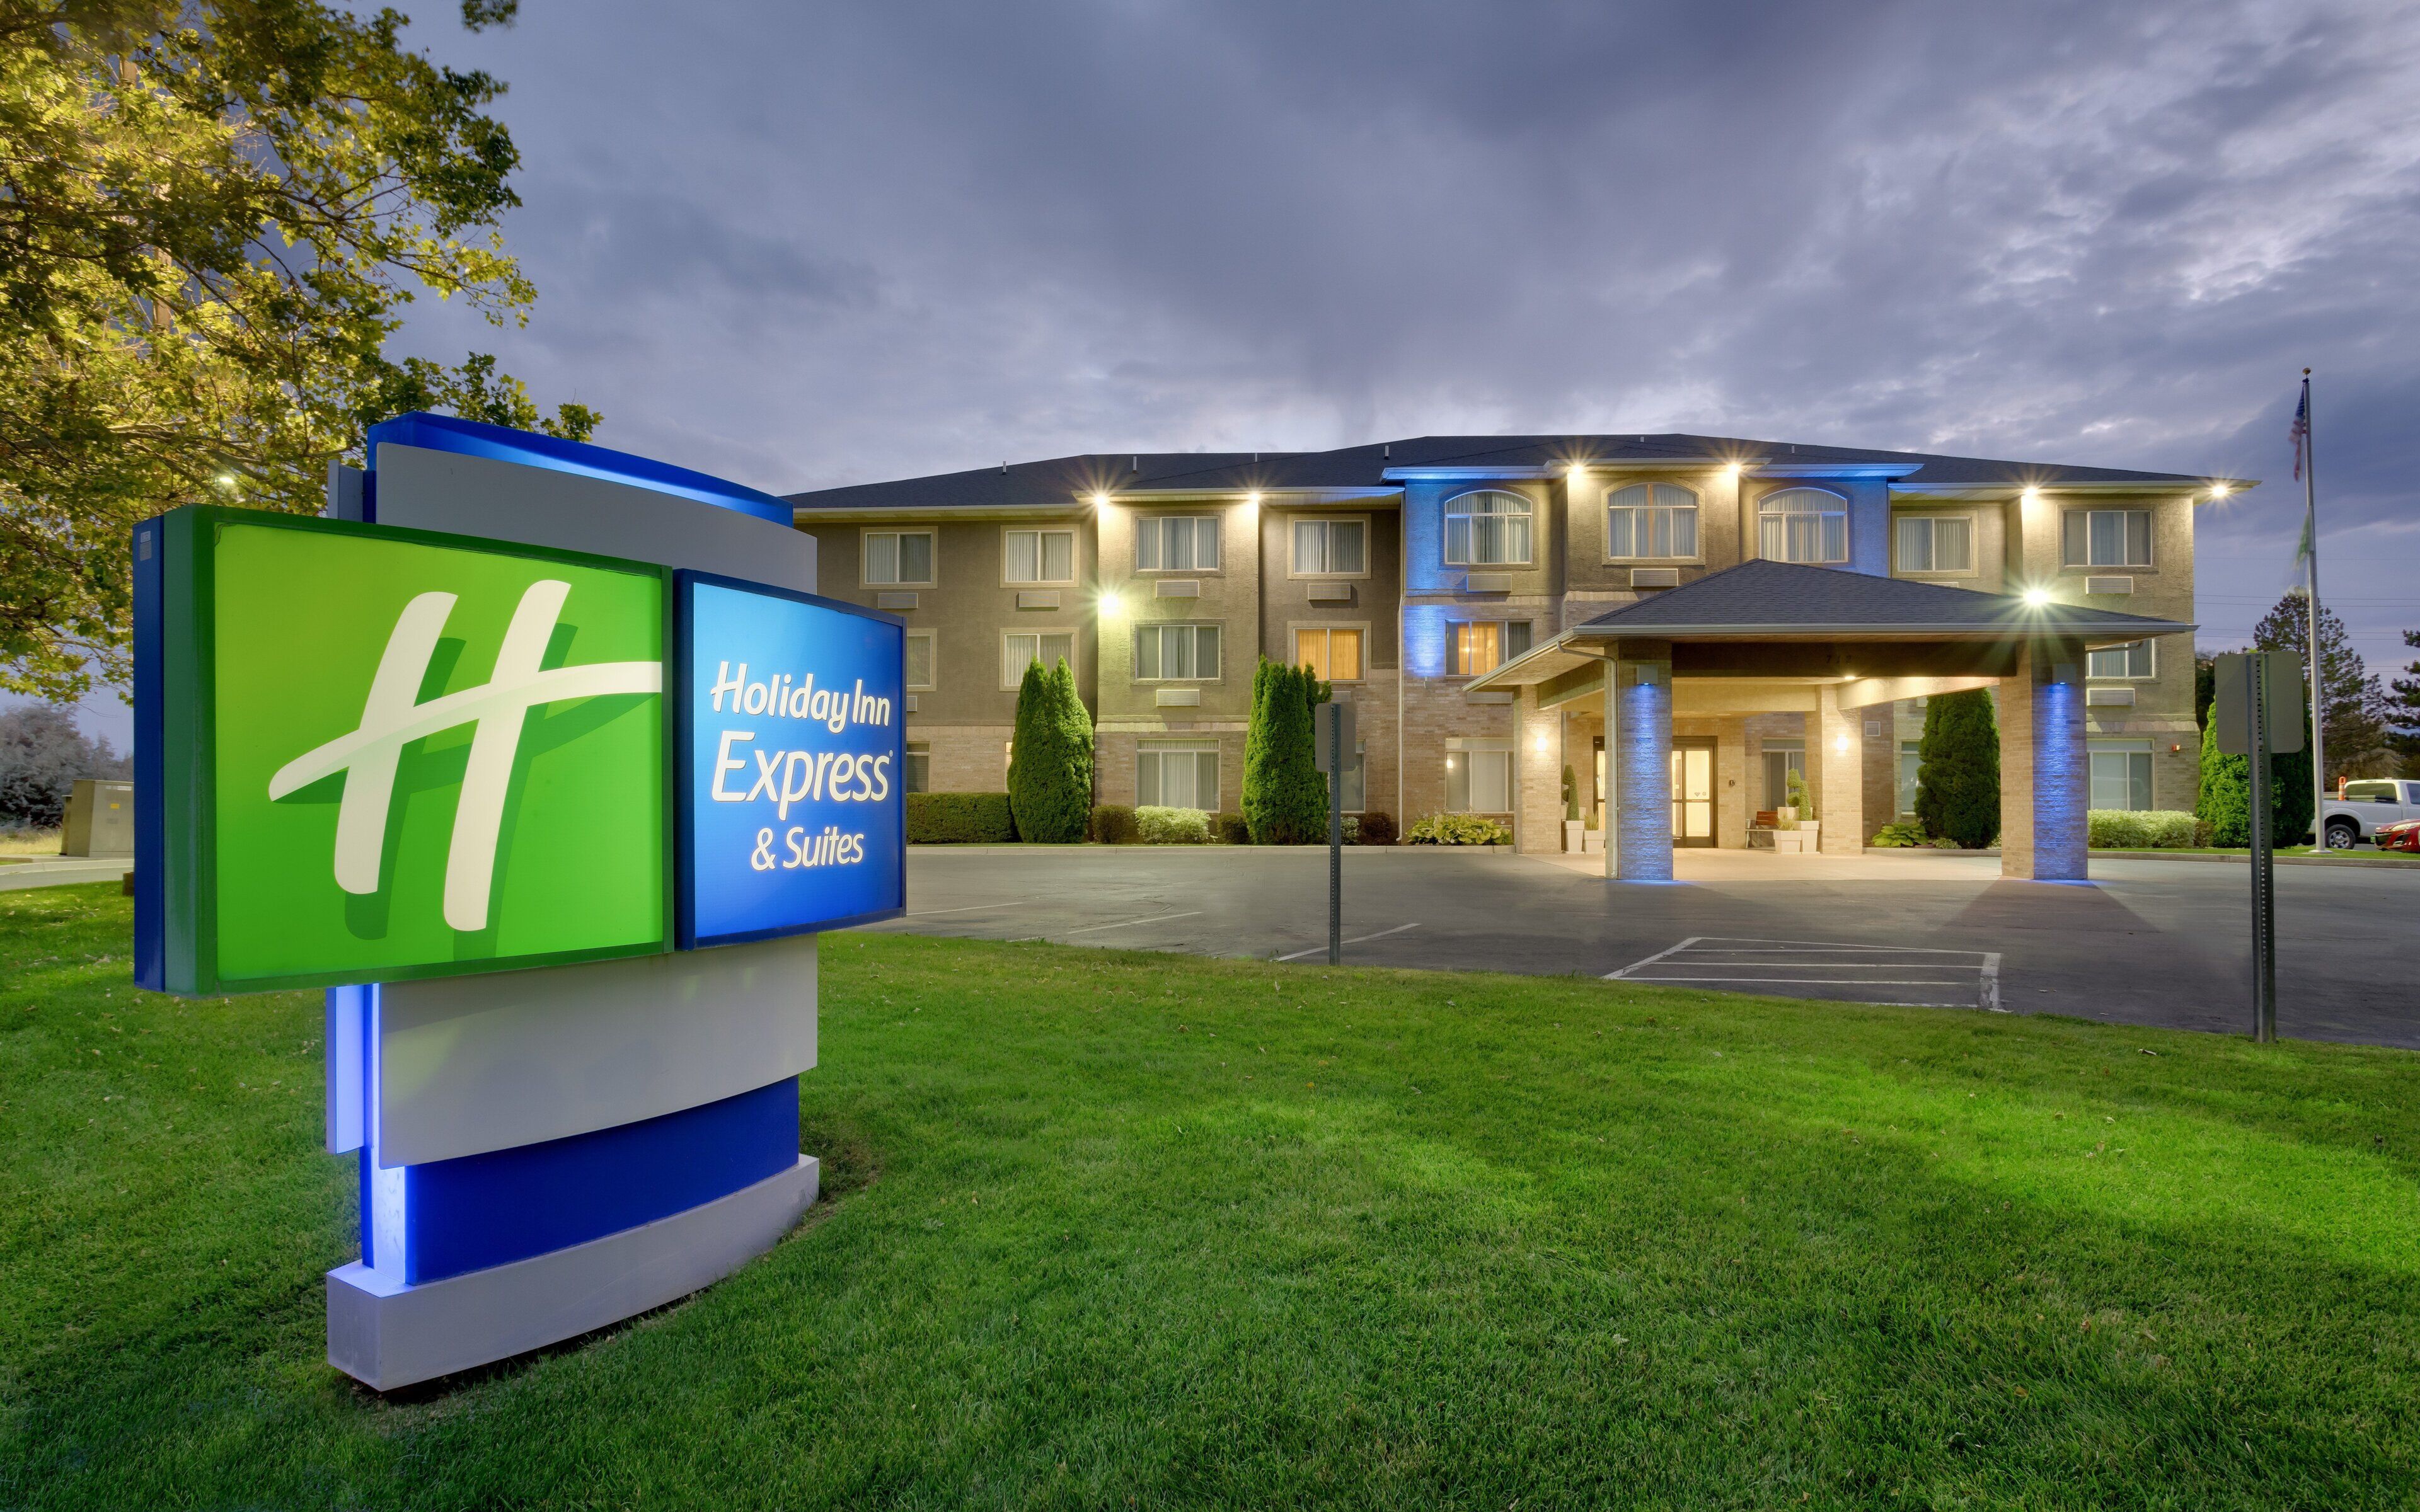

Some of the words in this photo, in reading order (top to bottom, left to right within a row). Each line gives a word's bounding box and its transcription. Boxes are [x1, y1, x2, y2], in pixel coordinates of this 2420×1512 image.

[710, 660, 850, 733] Holiday
[852, 679, 890, 726] Inn
[268, 580, 662, 931] H
[711, 730, 890, 821] Express
[751, 827, 776, 871] &
[782, 826, 864, 869] Suites
